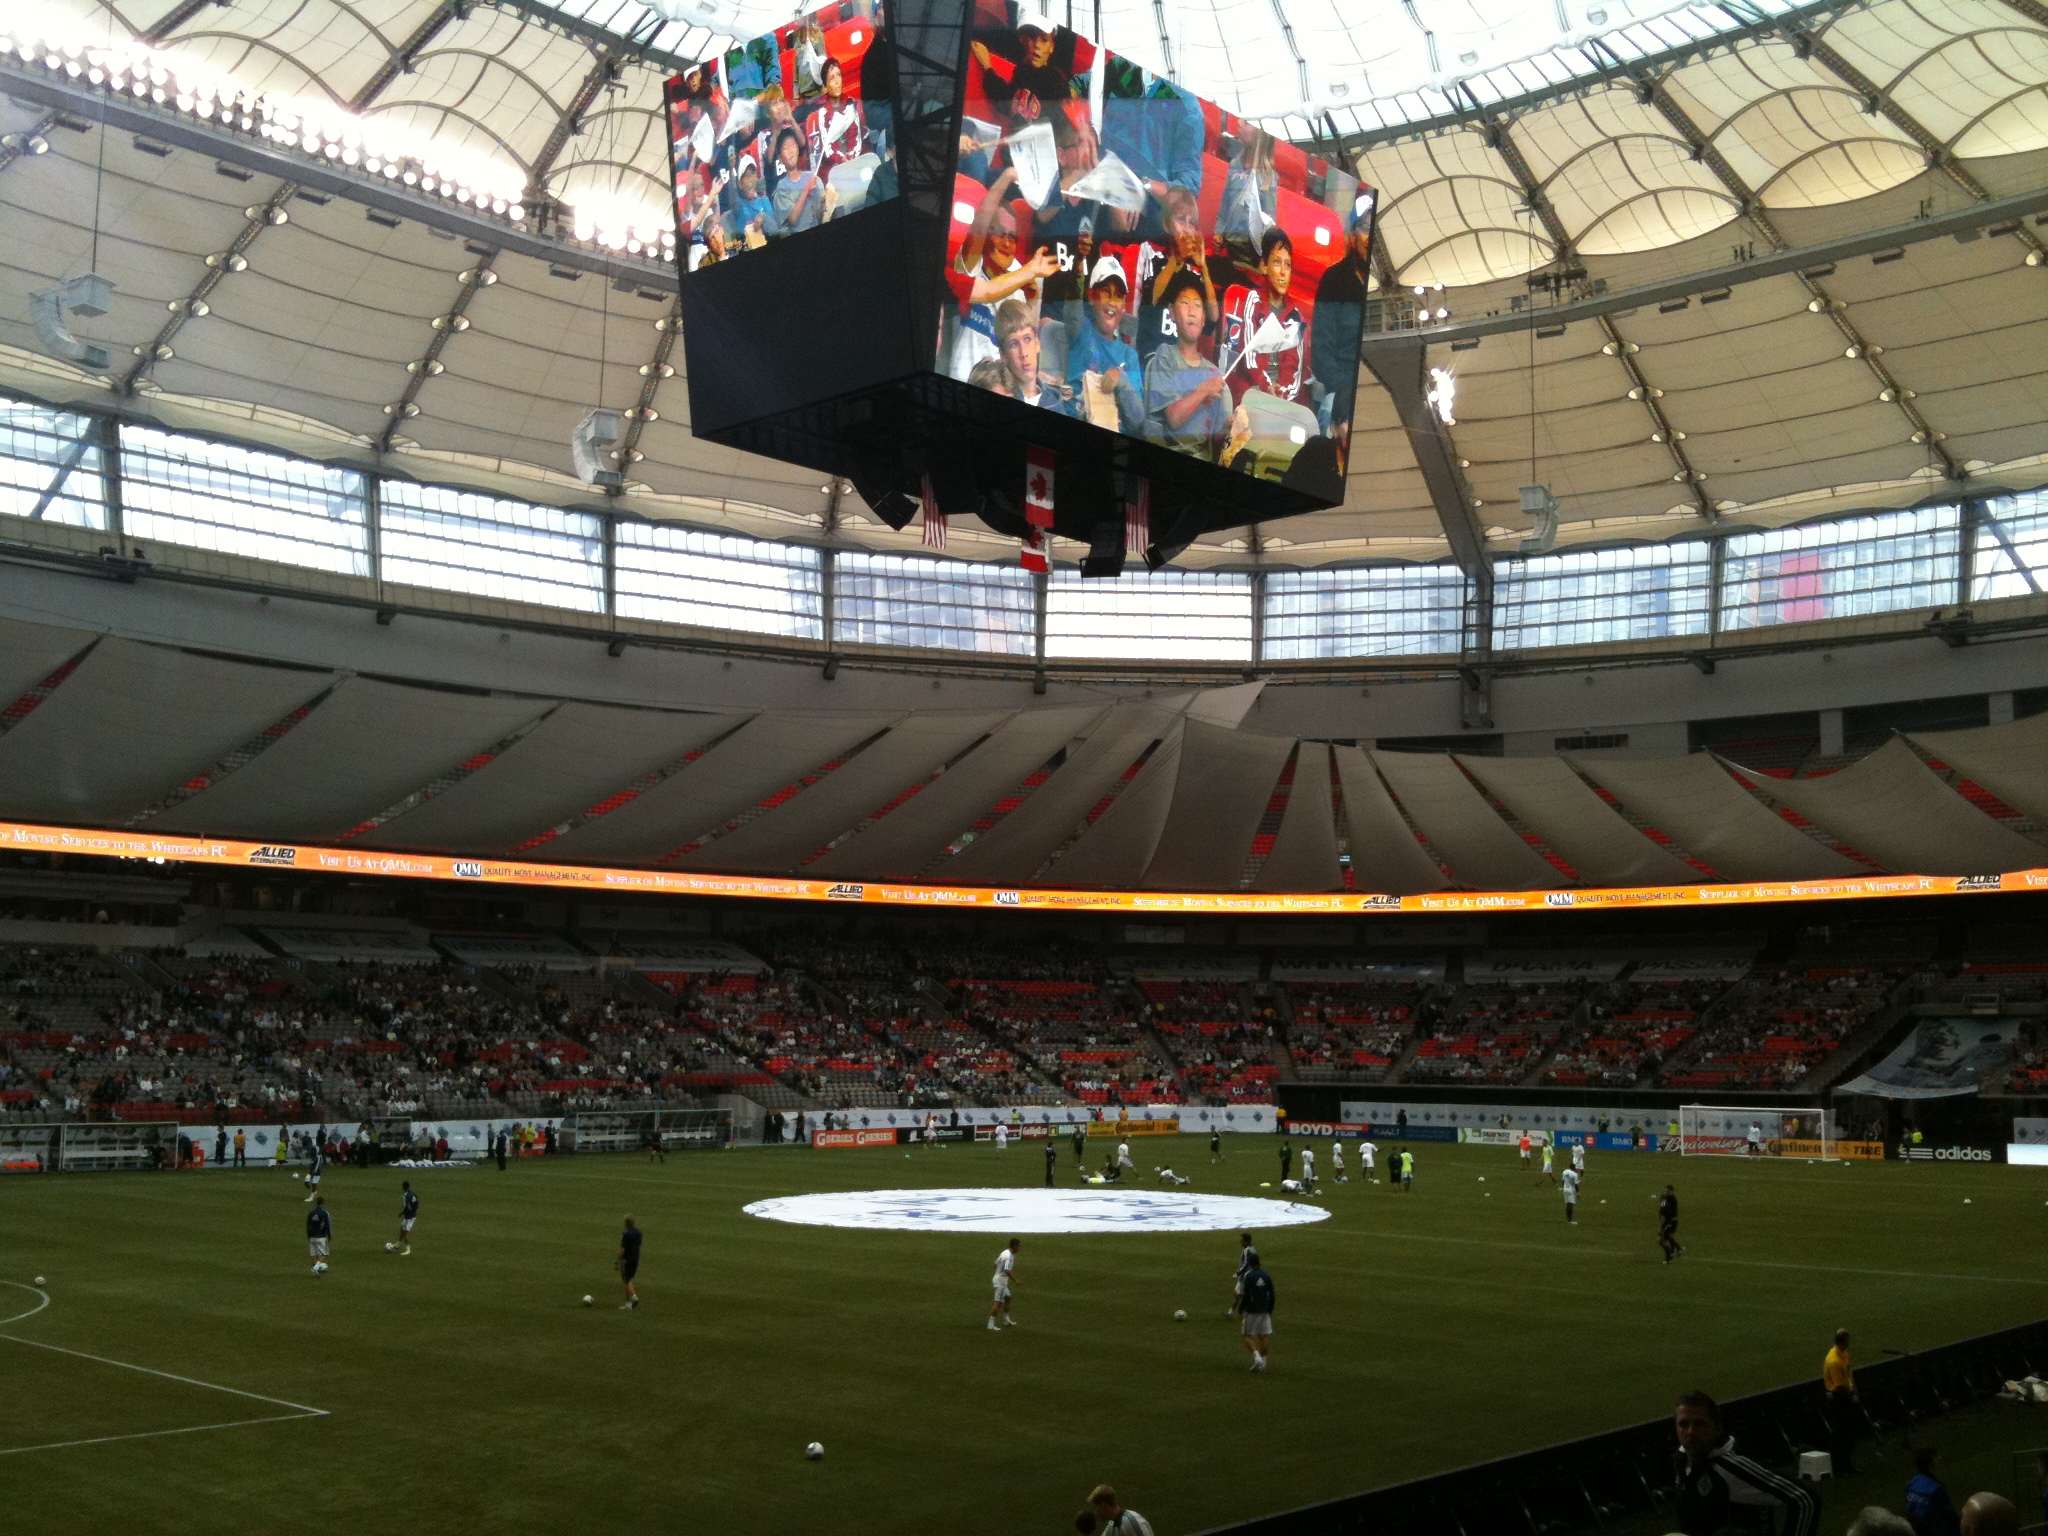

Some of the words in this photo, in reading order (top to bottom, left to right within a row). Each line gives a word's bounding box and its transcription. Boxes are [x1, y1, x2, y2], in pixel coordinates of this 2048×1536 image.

[453, 861, 482, 877] QMM
[994, 892, 1019, 905] QMM
[1545, 894, 1574, 906] QMM
[1289, 1123, 1334, 1136] BOYD
[1664, 1136, 1743, 1153] Budweiser
[1854, 1146, 1881, 1156] TIRE
[1935, 1146, 1992, 1161] adidas
